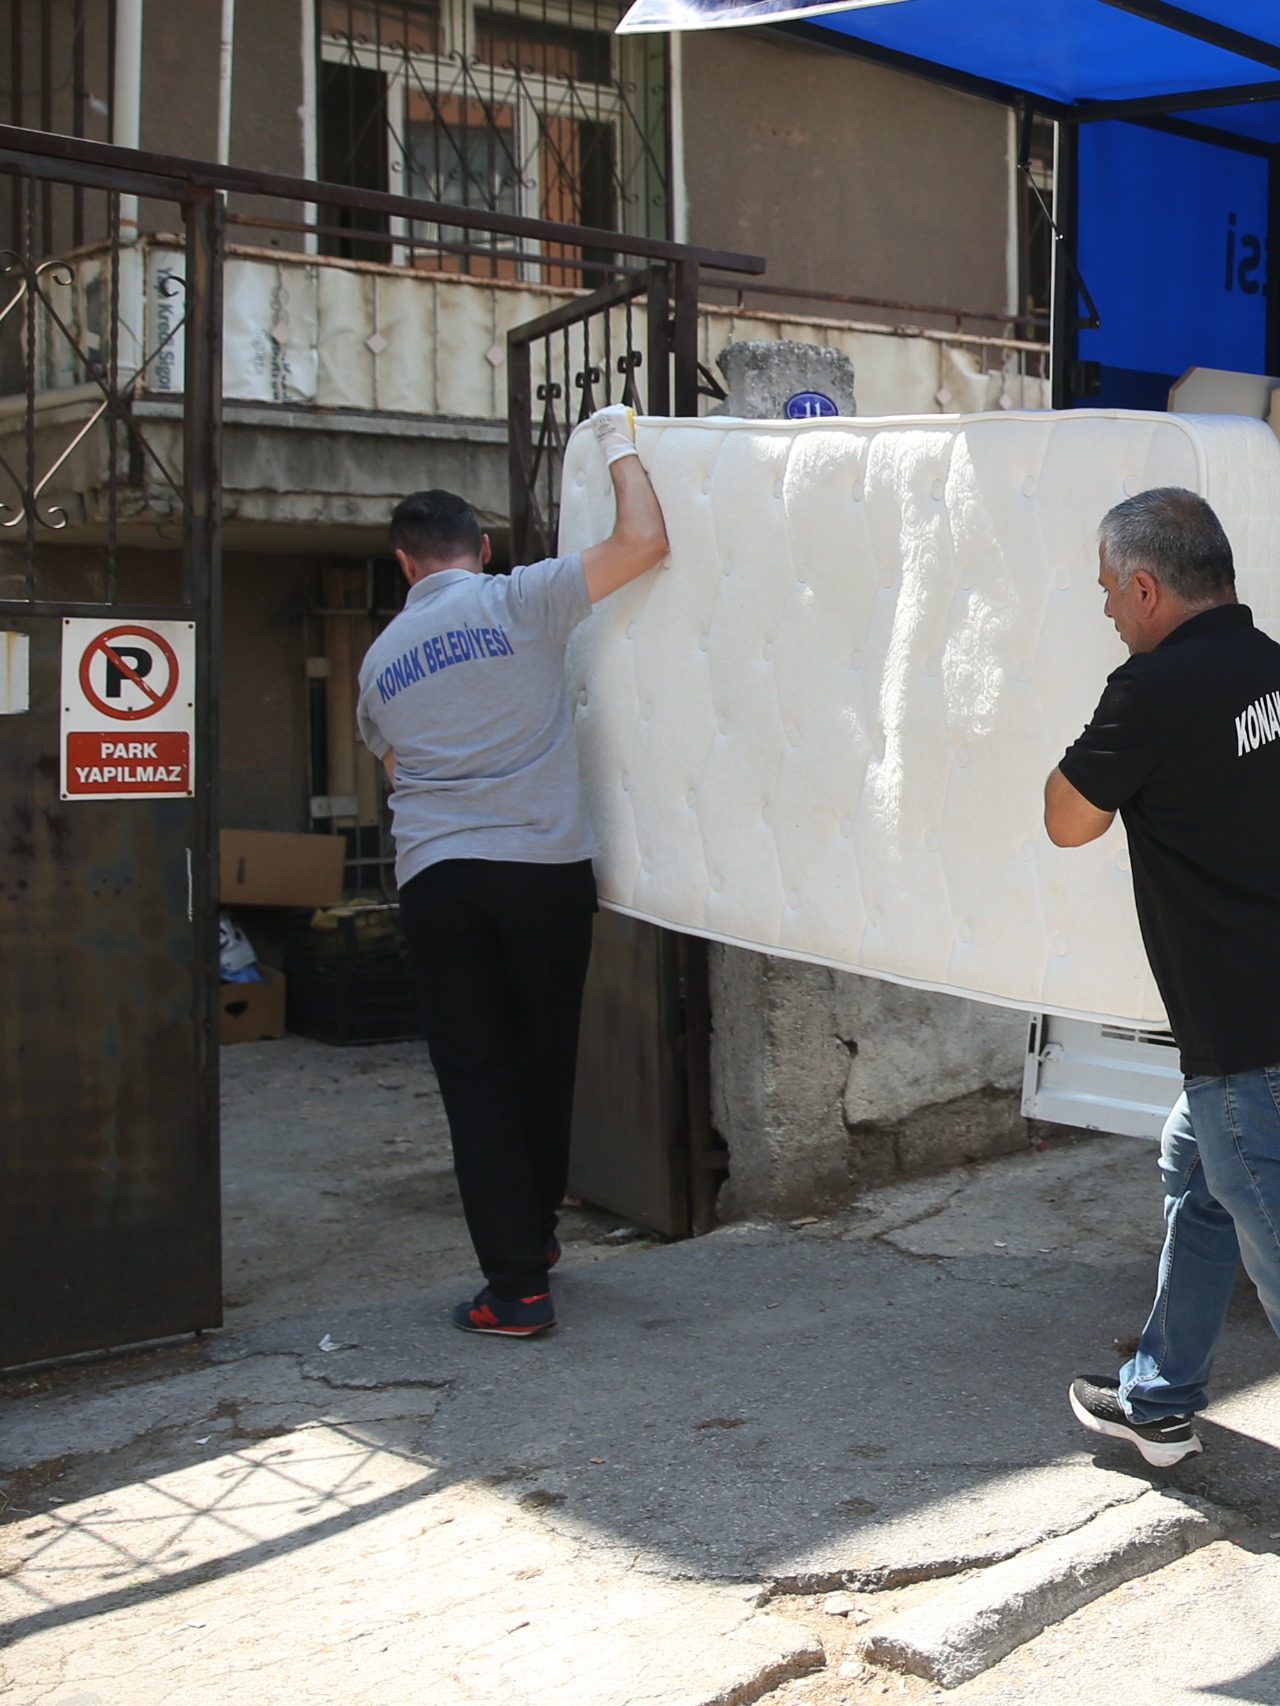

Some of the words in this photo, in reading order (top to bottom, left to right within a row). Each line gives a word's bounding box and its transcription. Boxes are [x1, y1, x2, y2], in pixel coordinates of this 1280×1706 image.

[376, 646, 426, 705] KONAK
[422, 622, 515, 674] BELEDİYESİ
[100, 742, 158, 759] PARK
[75, 766, 182, 783] YAPILMAZ
